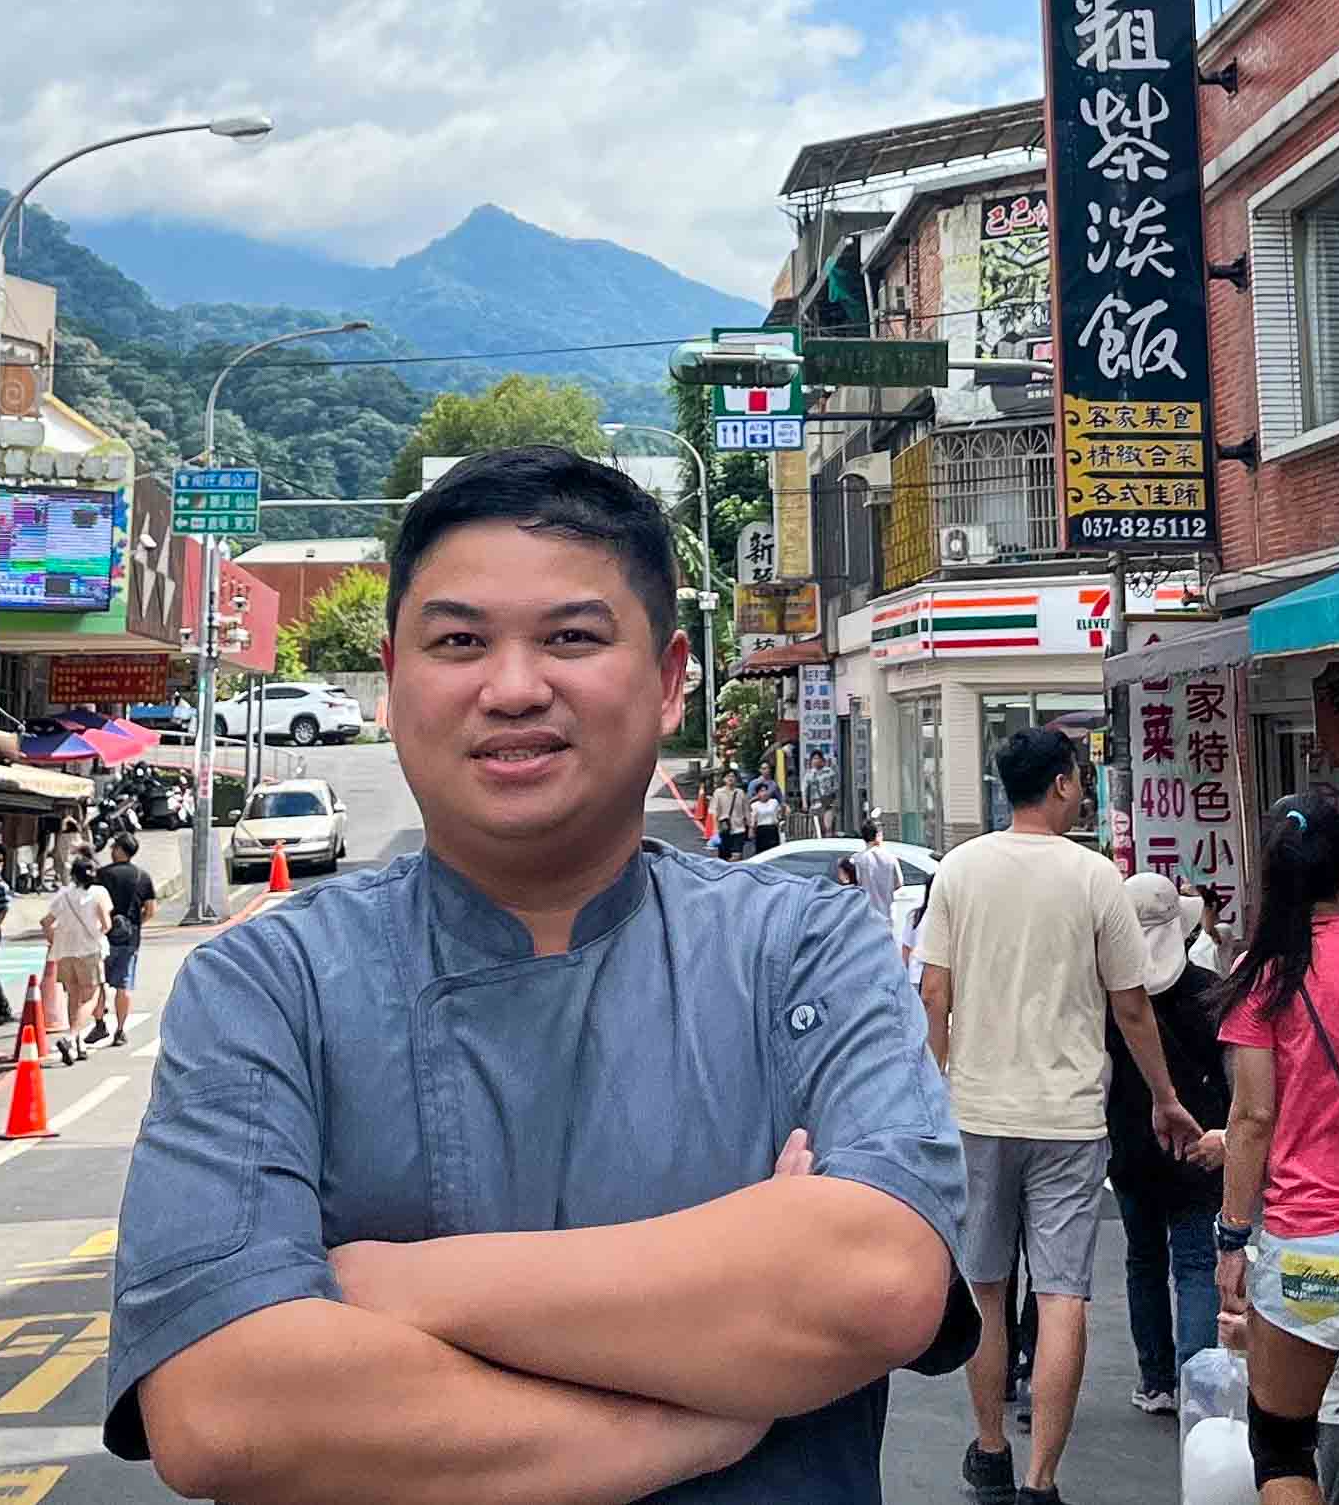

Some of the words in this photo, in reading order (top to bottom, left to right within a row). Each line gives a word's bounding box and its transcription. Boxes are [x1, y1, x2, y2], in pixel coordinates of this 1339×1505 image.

[1087, 405, 1195, 430] 客家美食
[1088, 482, 1202, 508] 各式佳餚
[1081, 516, 1207, 539] 037-825112
